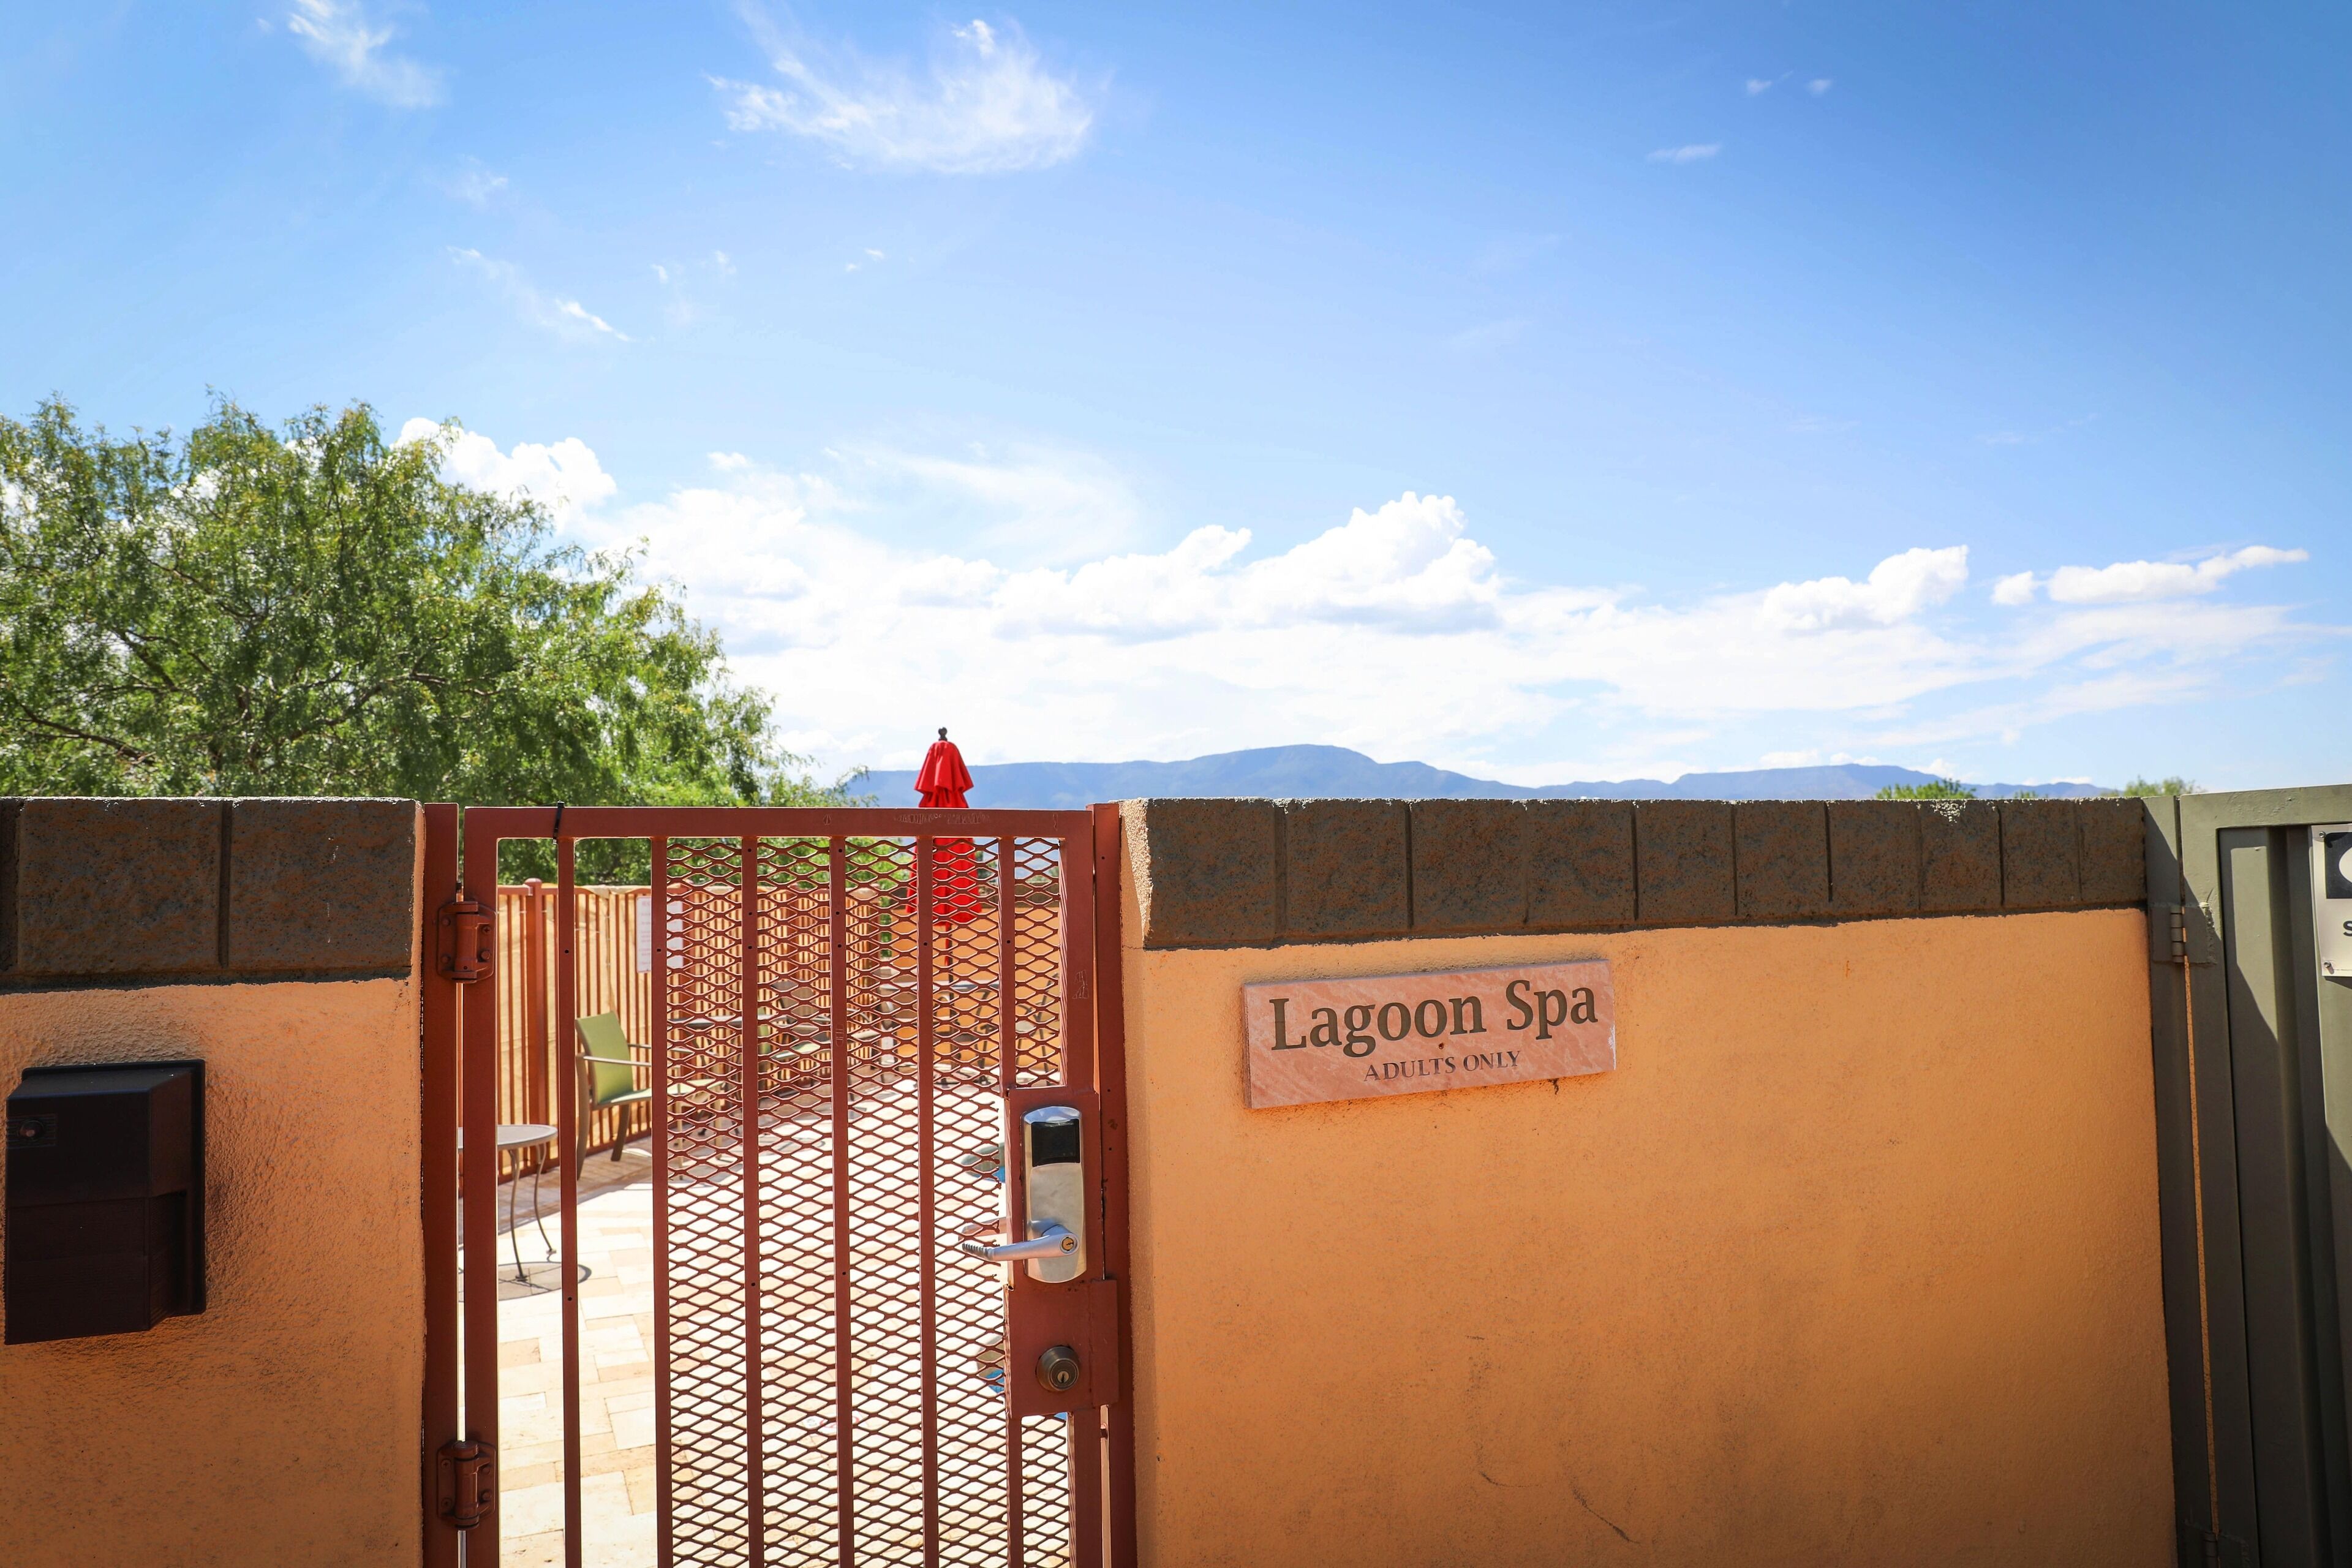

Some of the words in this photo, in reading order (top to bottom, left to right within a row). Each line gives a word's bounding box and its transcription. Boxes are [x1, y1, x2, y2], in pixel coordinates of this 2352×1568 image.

[1269, 994, 1487, 1058] Lagoon
[1506, 979, 1599, 1040] Spa
[1363, 1056, 1457, 1082] ADULTS
[1462, 1050, 1521, 1071] ONLY
